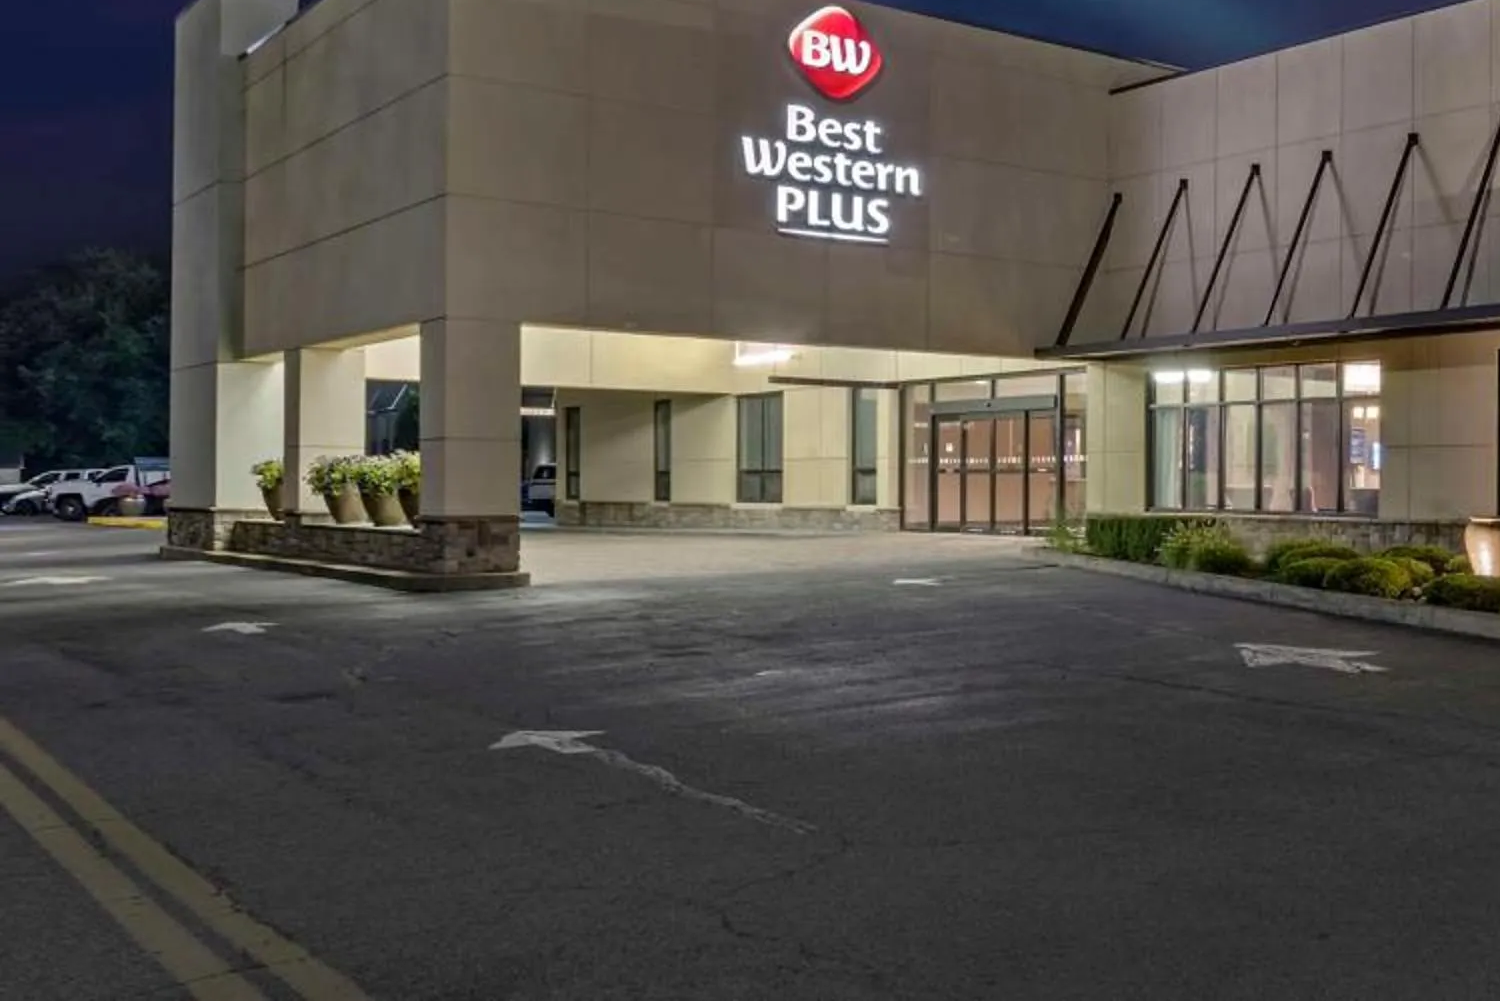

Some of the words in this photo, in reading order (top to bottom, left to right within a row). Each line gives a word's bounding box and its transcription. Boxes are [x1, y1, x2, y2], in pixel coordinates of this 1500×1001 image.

[802, 30, 871, 74] BW
[786, 104, 883, 154] Best
[741, 135, 922, 196] Western
[777, 185, 890, 234] PLUS
